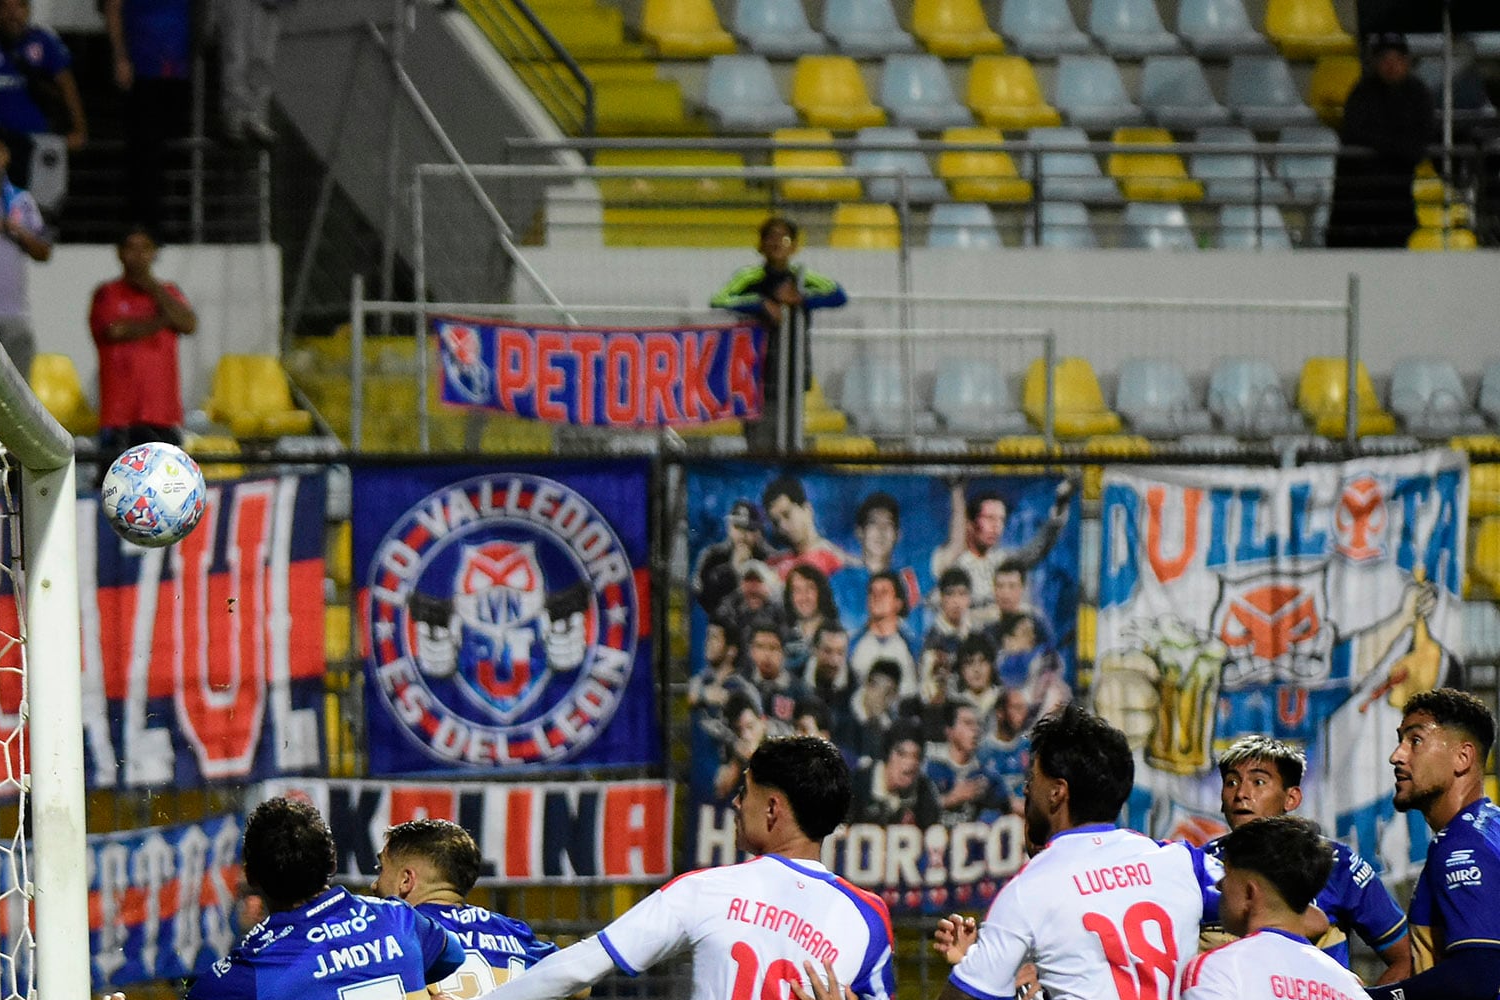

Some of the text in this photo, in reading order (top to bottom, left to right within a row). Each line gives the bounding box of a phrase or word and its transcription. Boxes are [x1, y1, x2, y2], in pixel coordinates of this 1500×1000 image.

[496, 326, 762, 425] PETORKA
[371, 478, 630, 607] LO VALLEDOR
[379, 644, 633, 765] ES DEL LEON
[1072, 861, 1153, 896] LUCERO
[306, 907, 372, 944] Claro
[312, 934, 404, 979] J.MOYA
[726, 897, 840, 965] ALTAMIRANO
